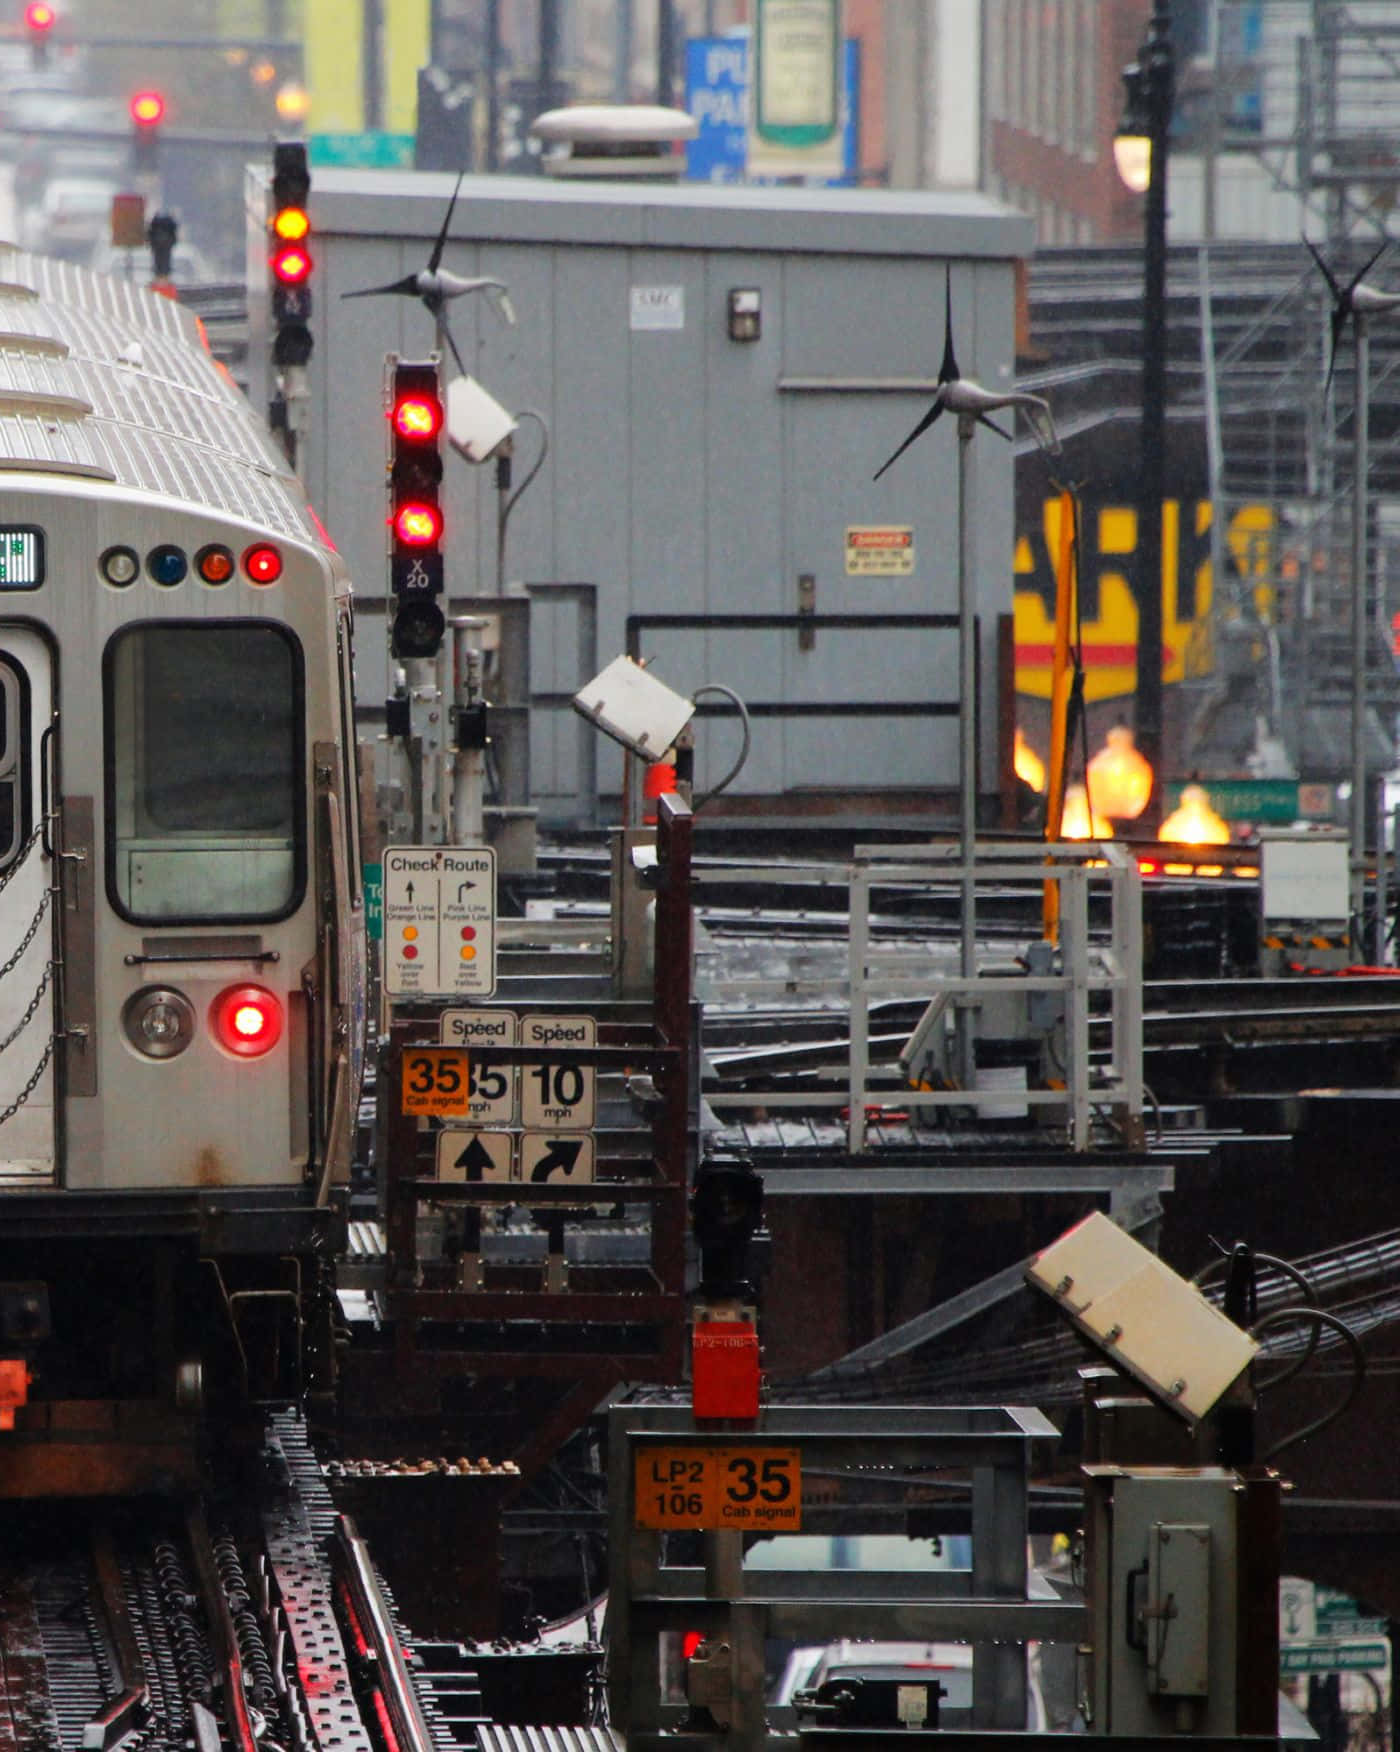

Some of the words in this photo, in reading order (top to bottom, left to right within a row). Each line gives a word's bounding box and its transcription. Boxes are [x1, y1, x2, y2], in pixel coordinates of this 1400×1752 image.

[411, 559, 424, 575] X
[407, 574, 429, 589] 20
[391, 857, 439, 873] Check
[444, 858, 489, 873] Route
[416, 904, 435, 913] Line
[468, 904, 486, 913] Line
[418, 913, 436, 922] Line
[472, 913, 490, 922] Line
[451, 1019, 506, 1039] Speed
[531, 1025, 586, 1045] Speed
[409, 1058, 462, 1093] 35
[531, 1064, 585, 1107] 10
[406, 1095, 429, 1106] Cab
[431, 1095, 465, 1109] signal
[544, 1107, 572, 1119] mph
[652, 1459, 704, 1483] LP2
[726, 1458, 791, 1503] 35
[656, 1493, 703, 1516] 106
[722, 1504, 751, 1518] Cab
[754, 1504, 796, 1520] signal
